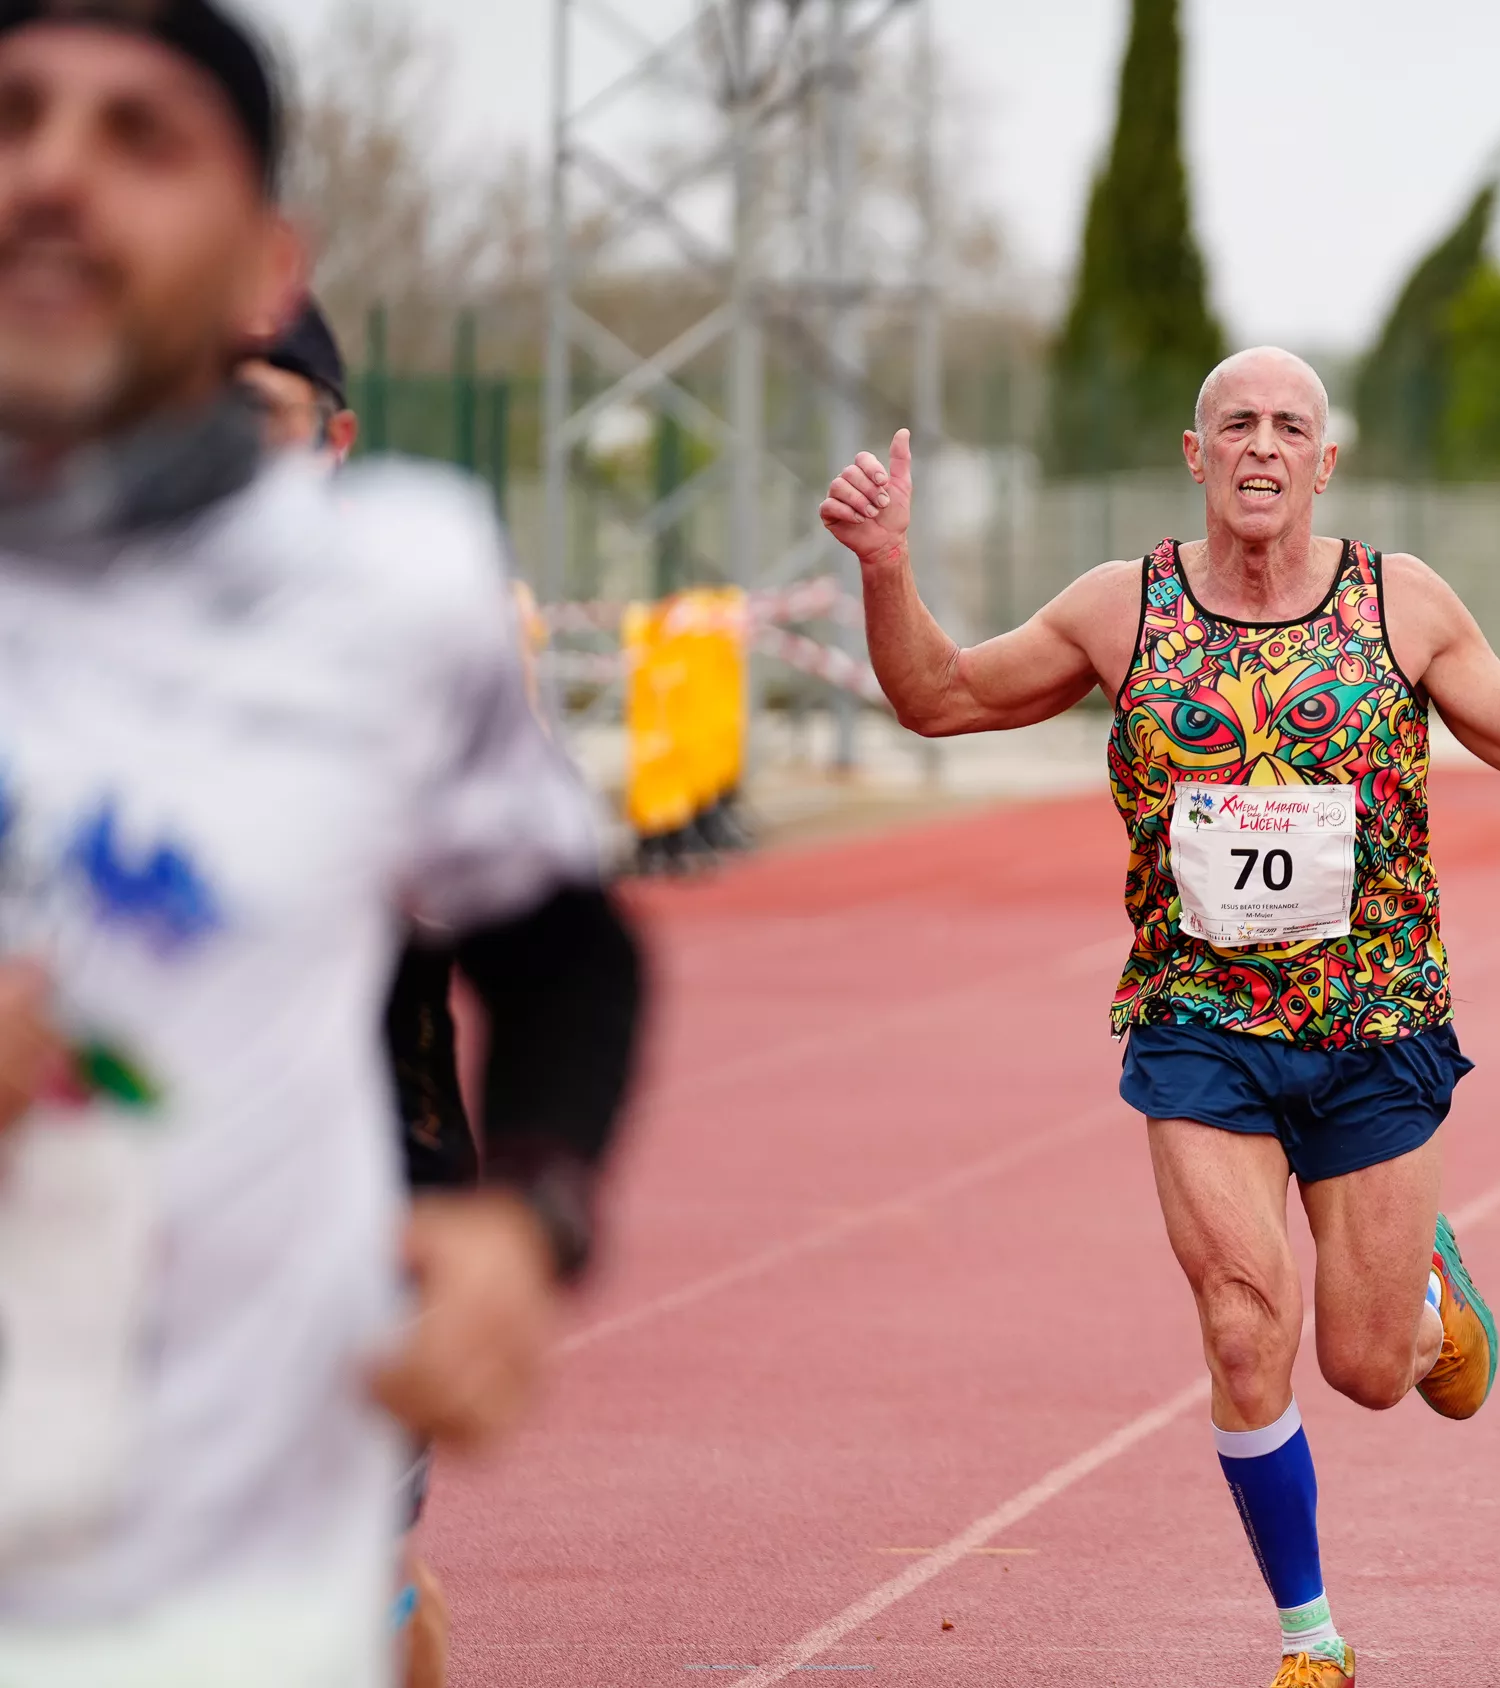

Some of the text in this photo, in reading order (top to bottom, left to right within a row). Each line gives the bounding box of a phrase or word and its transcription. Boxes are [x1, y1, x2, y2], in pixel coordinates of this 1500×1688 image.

[1219, 795, 1238, 818] X
[1233, 800, 1259, 812] MEDIA
[1240, 814, 1298, 833] LUCENA
[1230, 849, 1293, 891] 70
